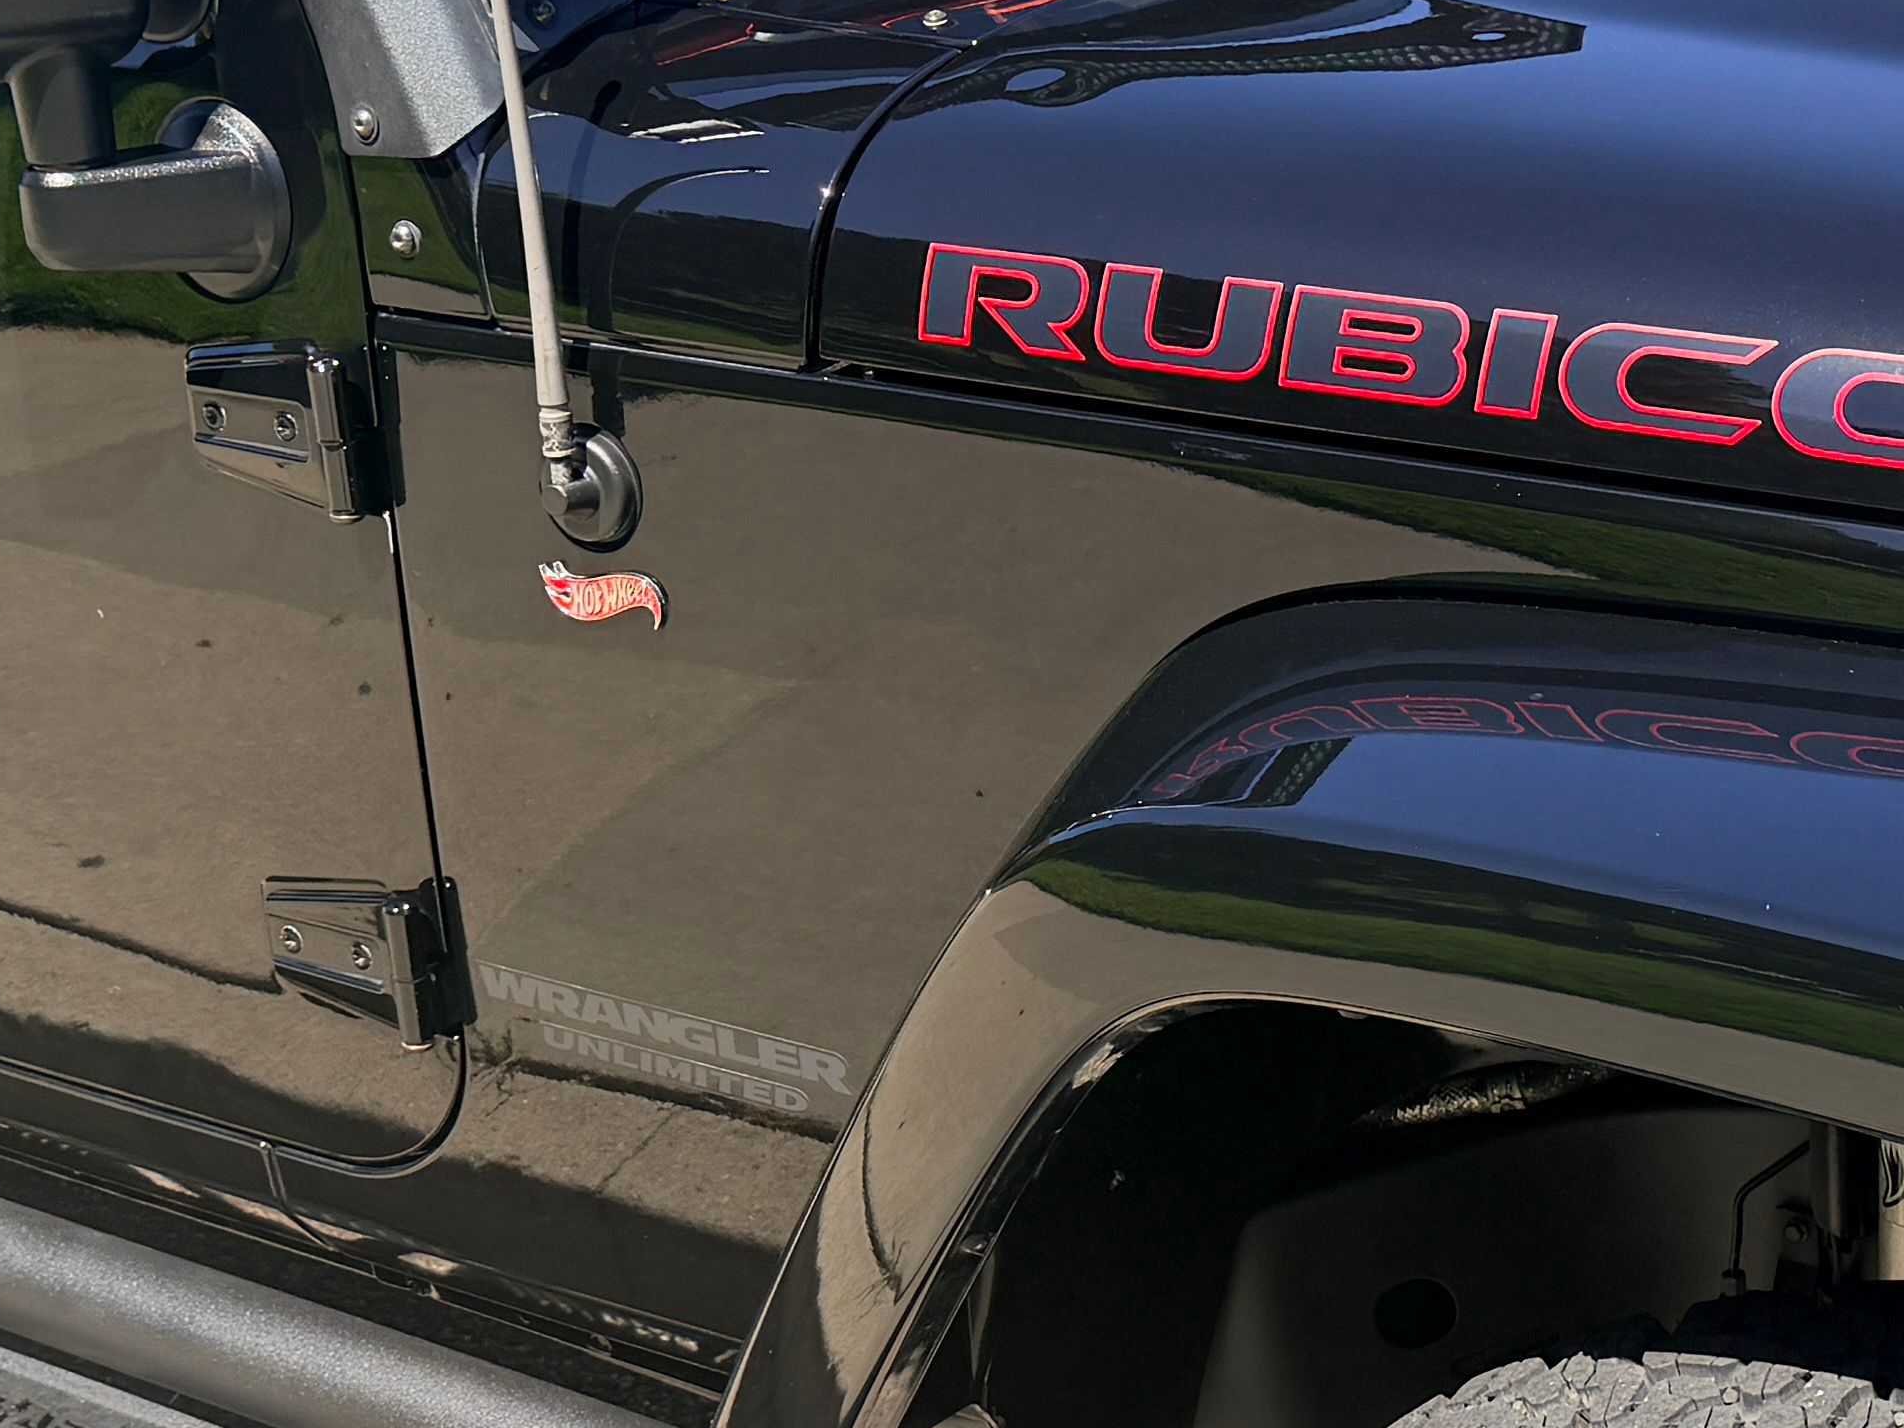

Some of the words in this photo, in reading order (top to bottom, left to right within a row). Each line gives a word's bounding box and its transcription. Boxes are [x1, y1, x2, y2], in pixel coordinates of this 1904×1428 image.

[572, 581, 603, 616] HOT
[478, 963, 854, 1096] WRANGLER
[541, 1024, 810, 1113] UNLIMITED
